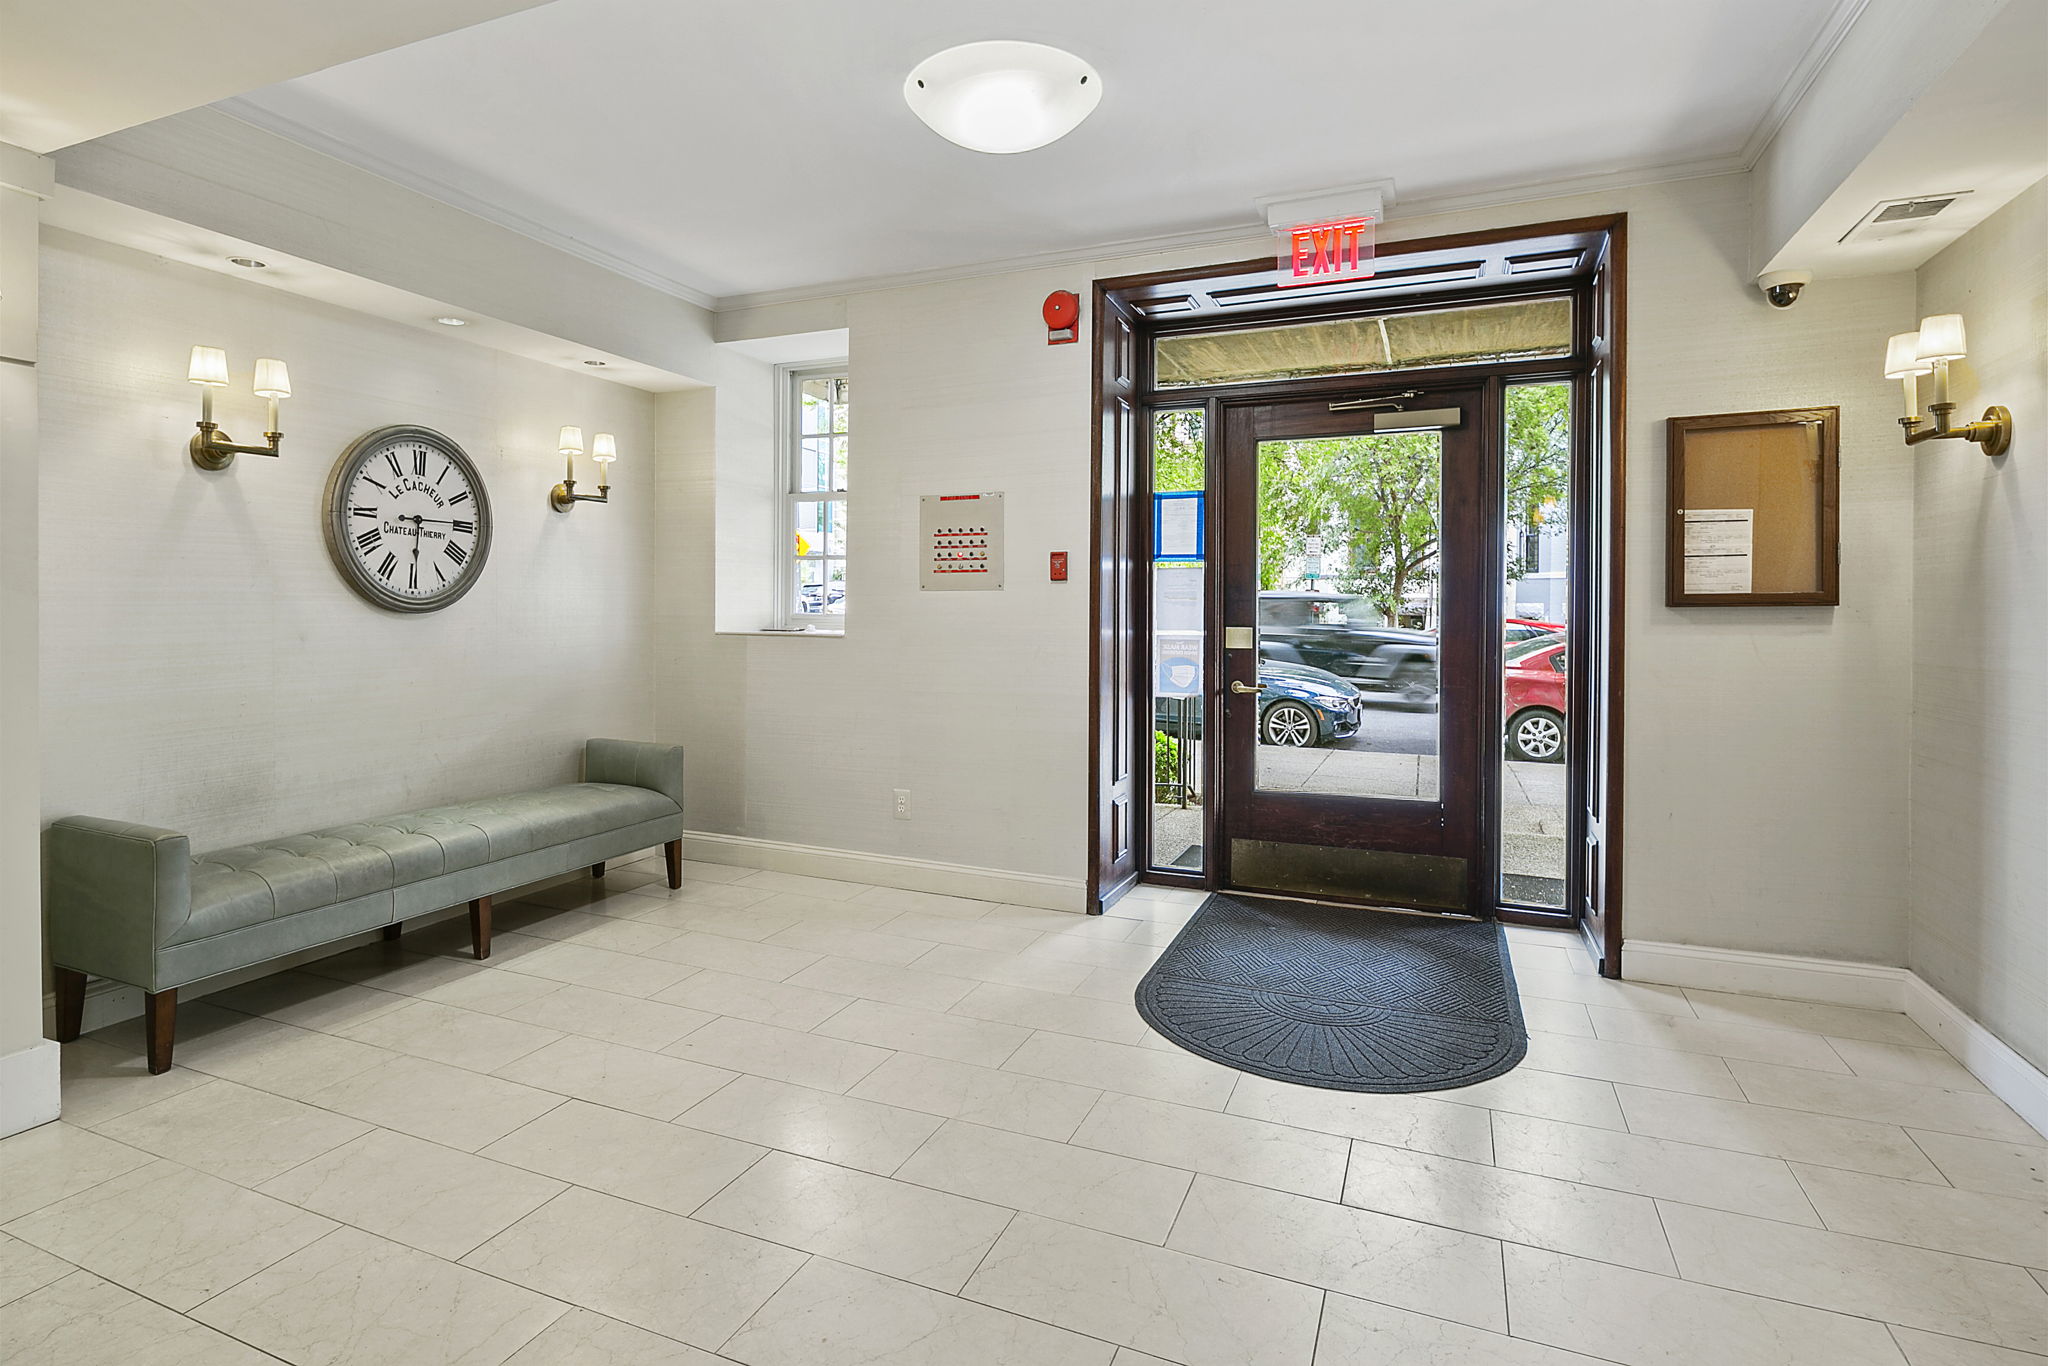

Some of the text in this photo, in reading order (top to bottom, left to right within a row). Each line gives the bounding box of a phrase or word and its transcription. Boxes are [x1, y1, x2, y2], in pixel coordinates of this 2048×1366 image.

[1292, 223, 1365, 277] EXIT
[411, 449, 427, 477] XII
[388, 478, 445, 509] LE CACHEUR
